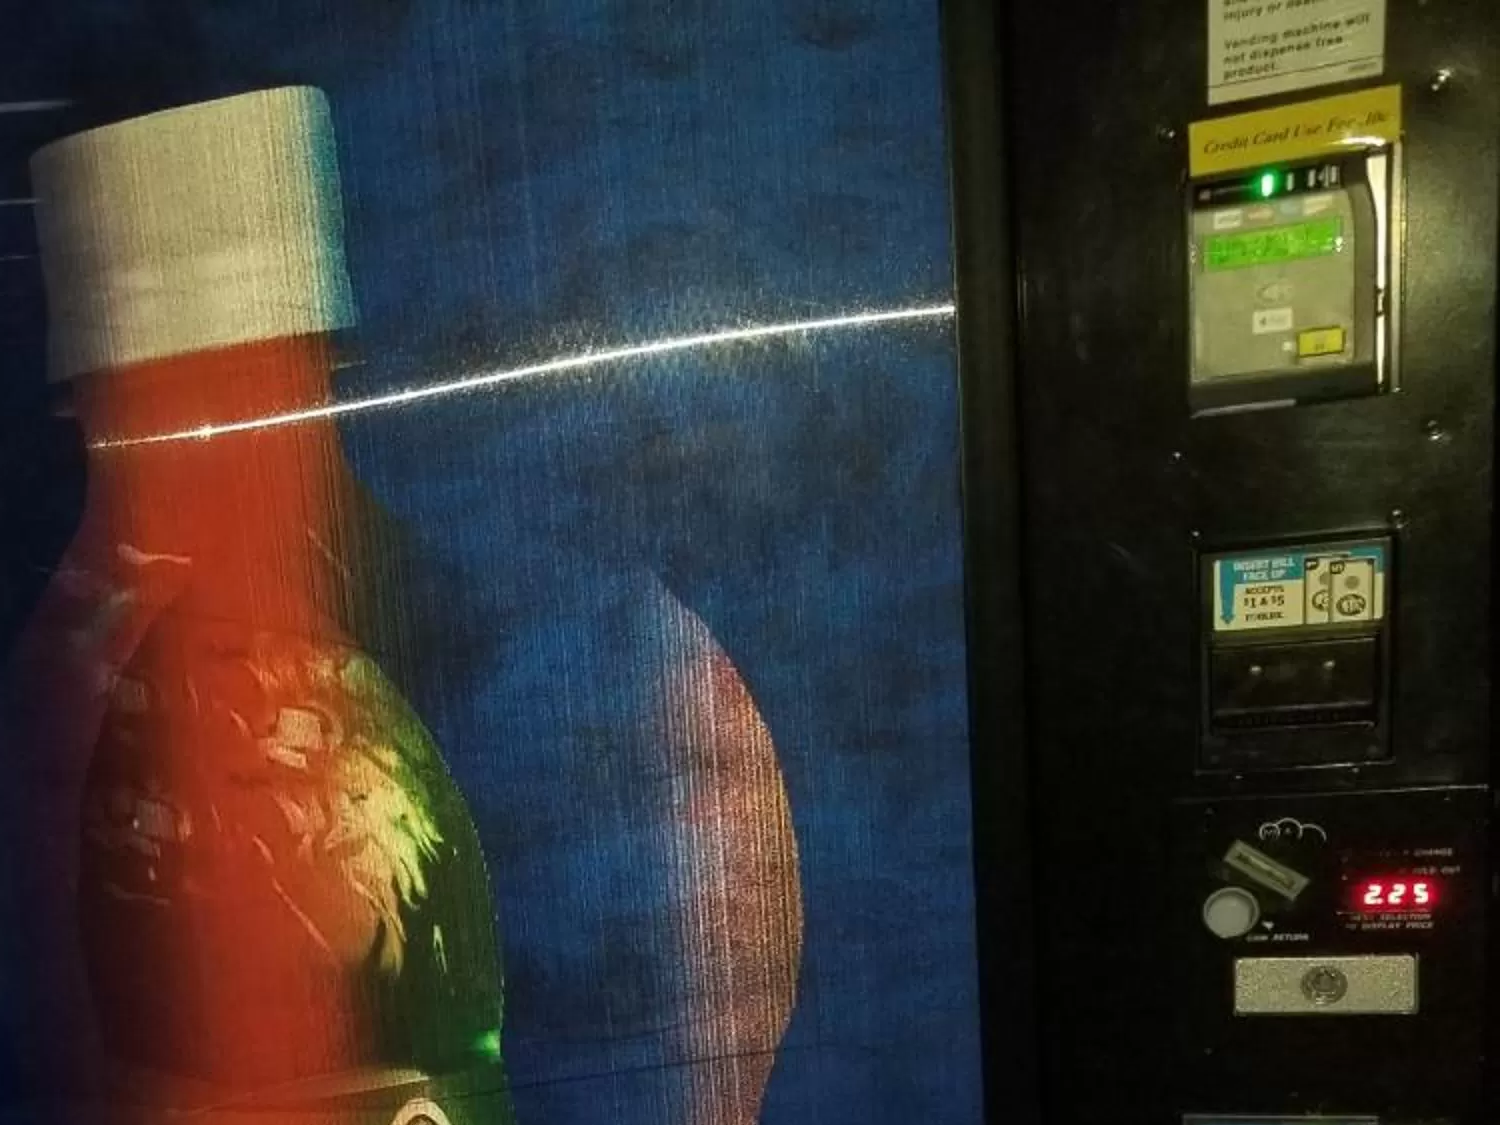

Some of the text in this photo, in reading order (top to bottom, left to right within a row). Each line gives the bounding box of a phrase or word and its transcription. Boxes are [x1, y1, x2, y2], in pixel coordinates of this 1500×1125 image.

[1223, 12, 1371, 49] Vending machine will
[1223, 35, 1344, 65] not dispense free
[1203, 135, 1249, 154] Credit
[1252, 127, 1290, 146] Card
[1272, 932, 1310, 942] RETURN
